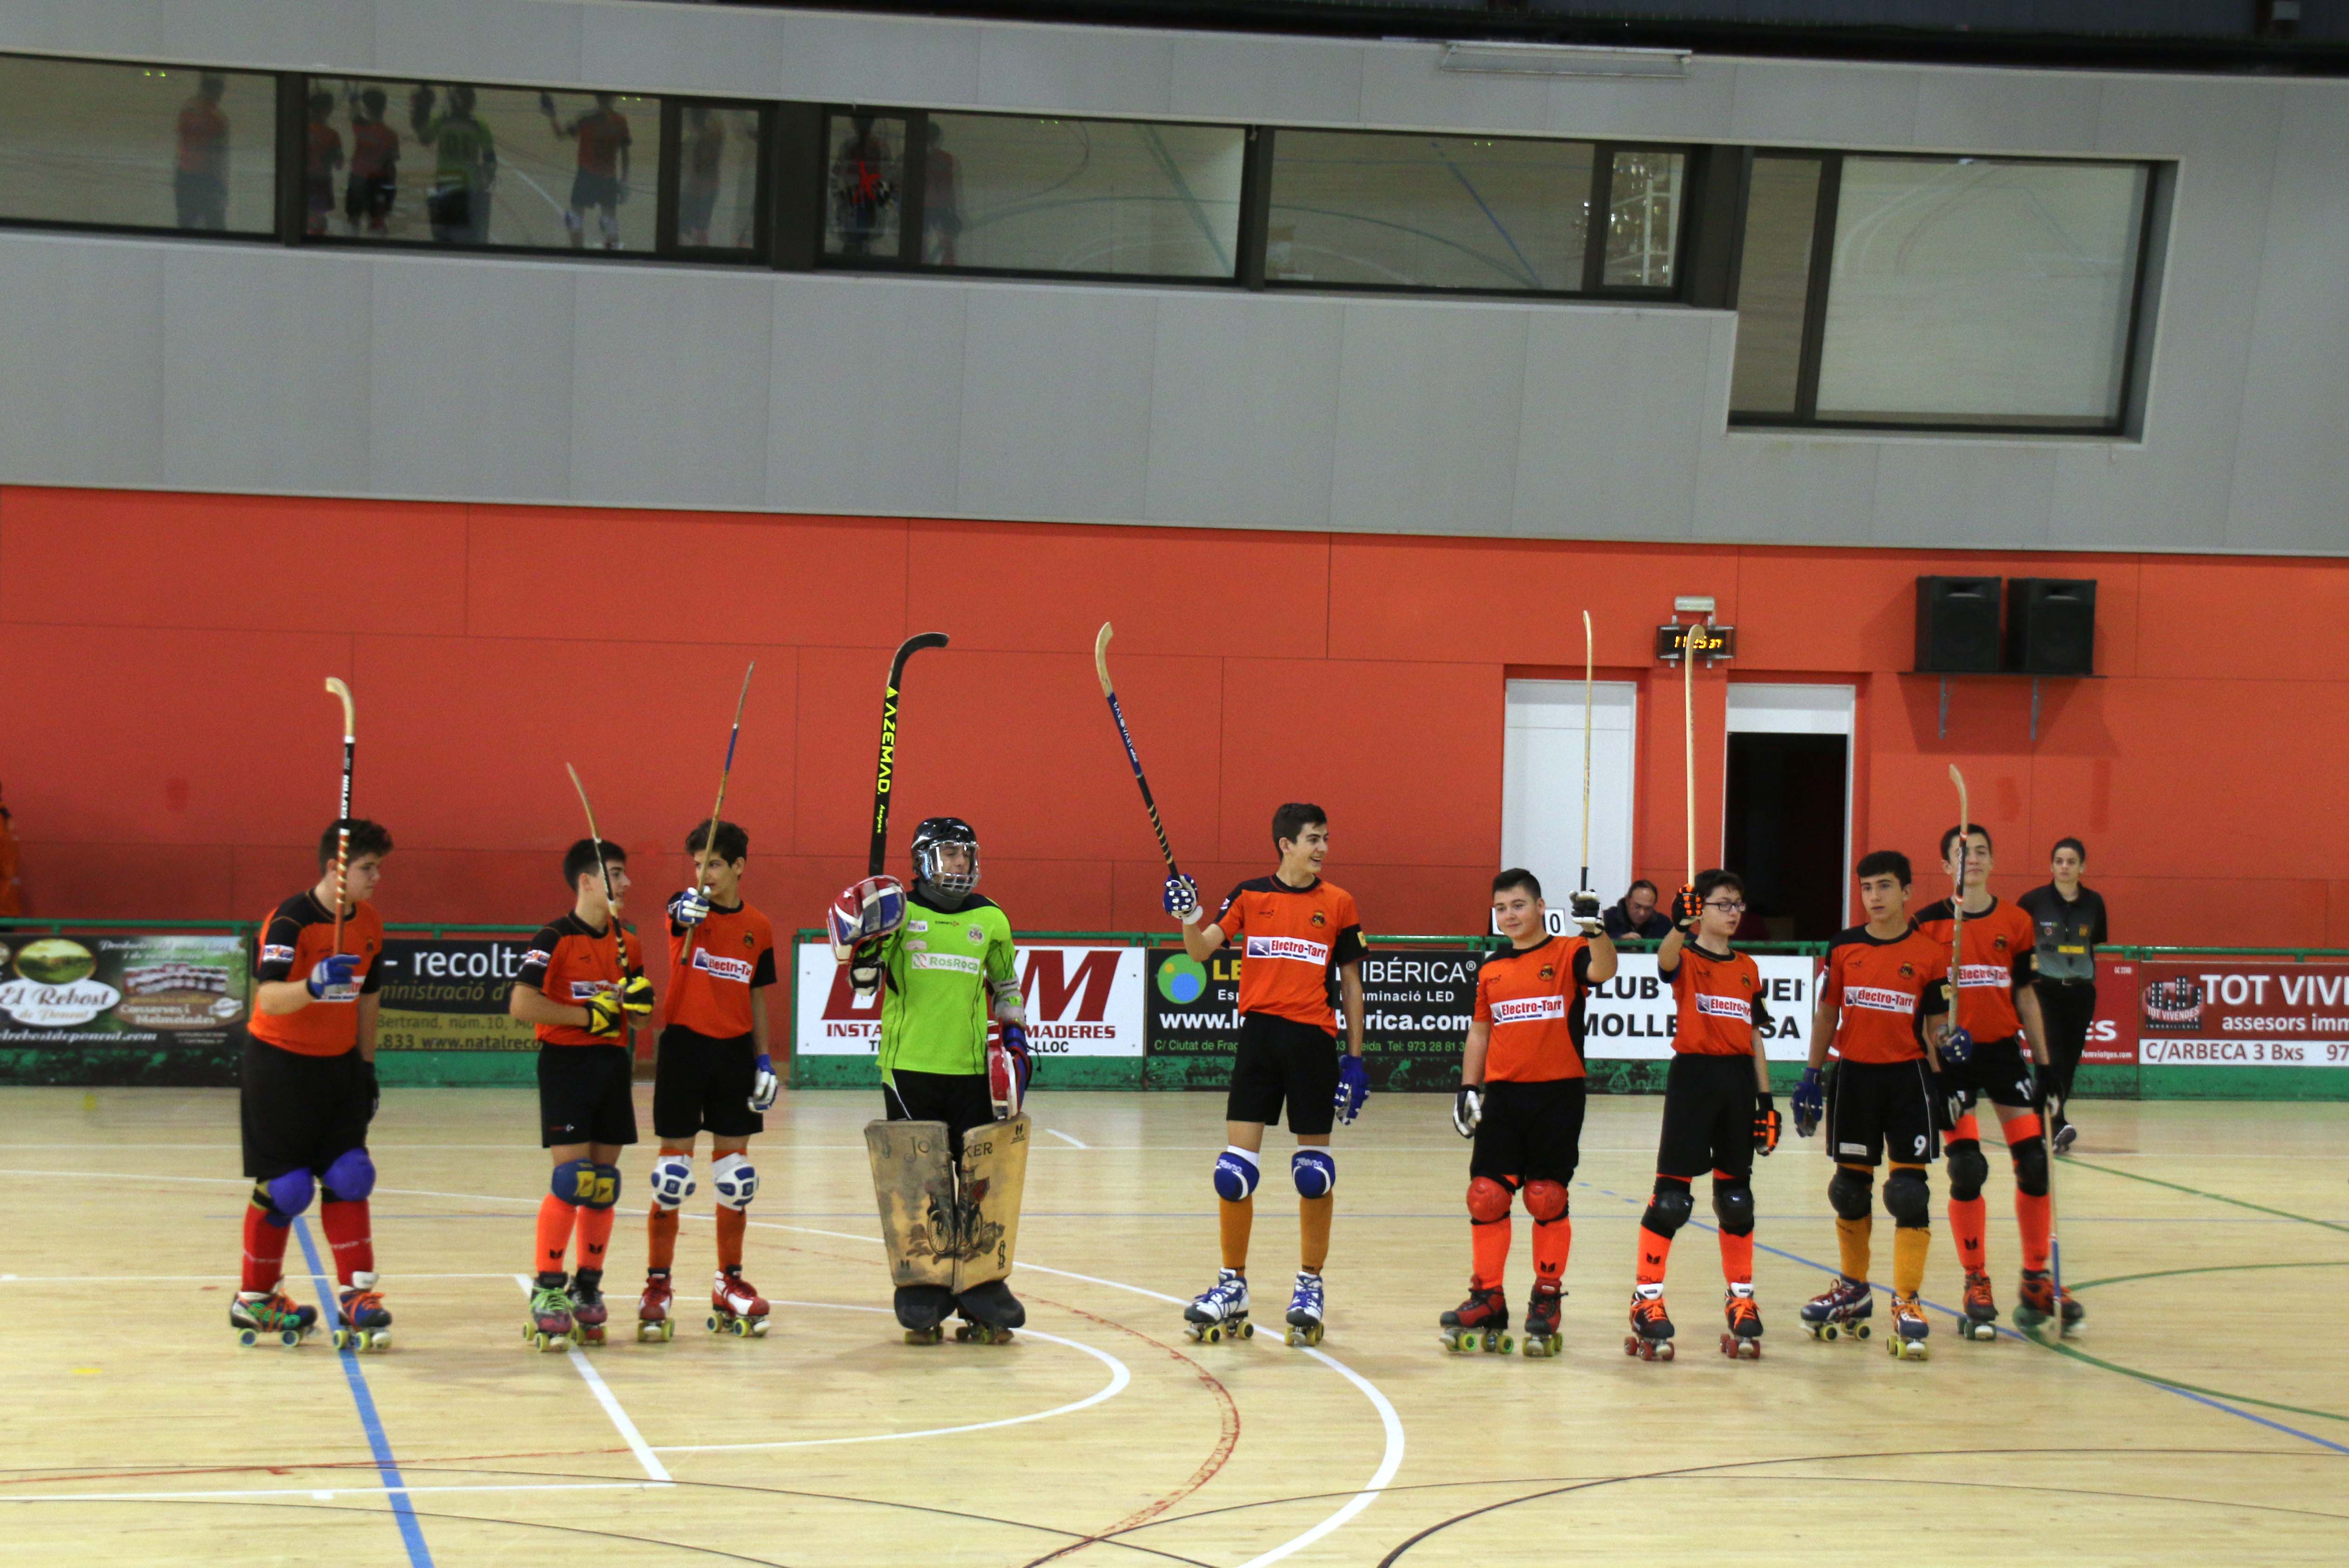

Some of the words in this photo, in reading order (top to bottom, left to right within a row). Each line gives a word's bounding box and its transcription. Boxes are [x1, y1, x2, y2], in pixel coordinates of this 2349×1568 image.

[1271, 939, 1326, 958] Electro-Tarr
[930, 956, 978, 971] RosRoca
[32, 985, 110, 1006] Rebost
[1586, 976, 1659, 999] LUB
[2200, 974, 2270, 1005] TOT
[1427, 991, 1454, 1002] LED
[1857, 989, 1913, 1006] Electro-Tarr
[1501, 999, 1562, 1016] Electro-Tarr
[1025, 1025, 1116, 1039] MADERES
[2221, 1016, 2306, 1031] assesors
[1168, 1039, 1199, 1051] Ciutat
[1201, 1039, 1215, 1051] de
[1387, 1041, 1404, 1051] Tel:
[1407, 1041, 1427, 1051] 973
[1429, 1041, 1442, 1051] 28
[1444, 1041, 1455, 1051] 81
[2145, 1040, 2247, 1062] C/ARBECA
[2253, 1044, 2264, 1060] 3
[2271, 1044, 2303, 1060] Bxs
[1913, 1134, 1926, 1156] 9
